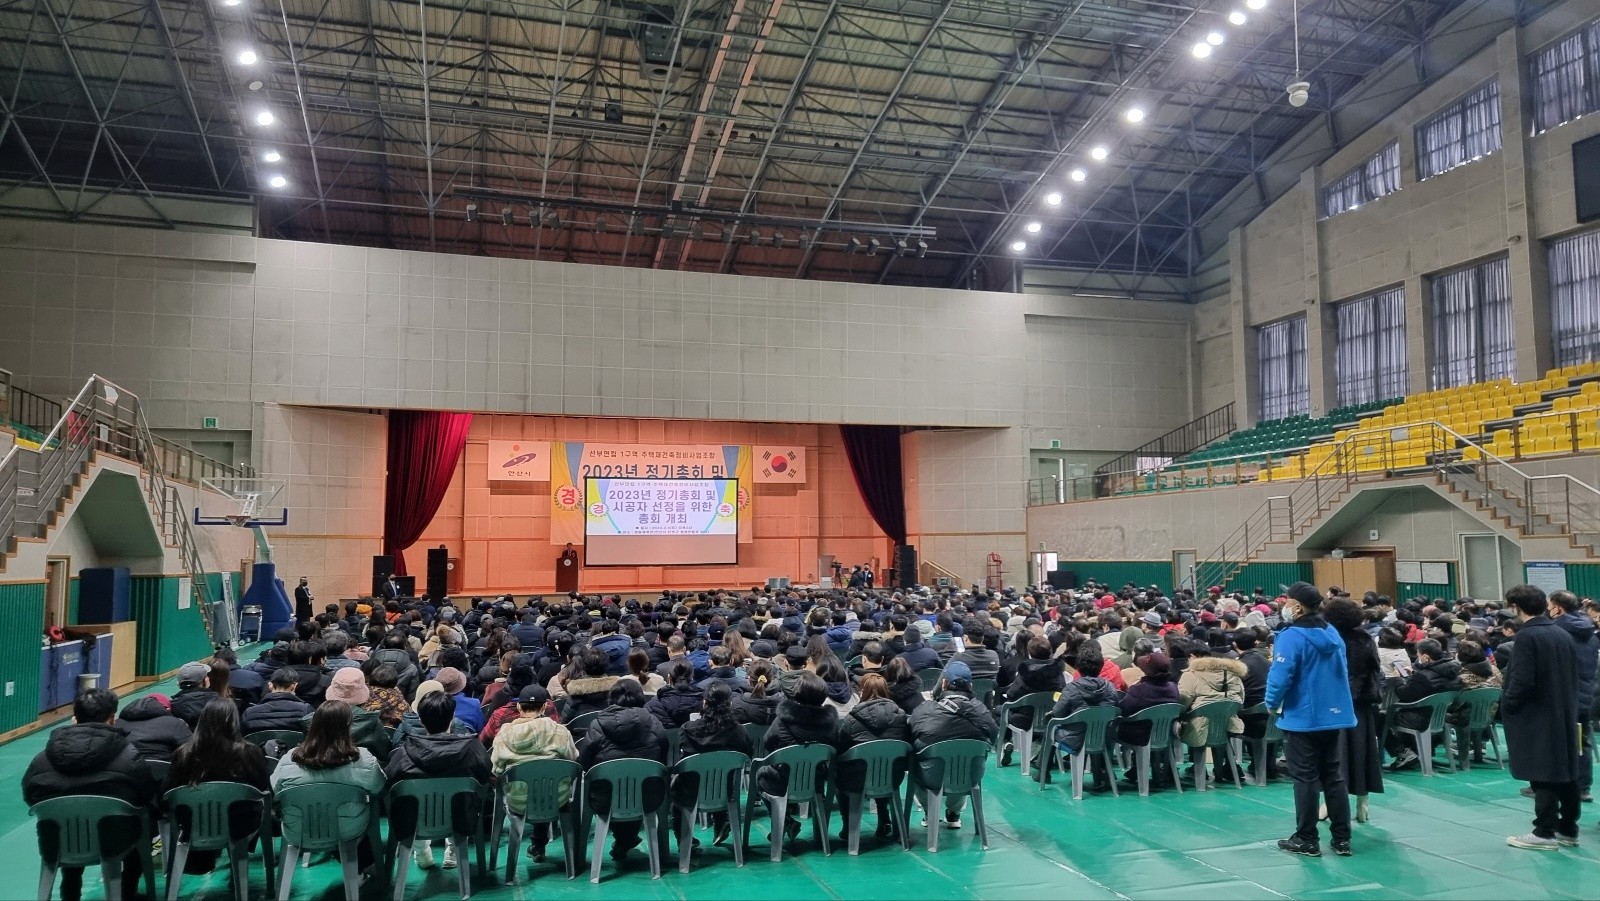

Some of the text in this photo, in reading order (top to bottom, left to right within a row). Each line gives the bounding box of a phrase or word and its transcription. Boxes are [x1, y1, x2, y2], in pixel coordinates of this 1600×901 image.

[589, 450, 617, 458] 선부연립
[582, 464, 638, 478] 2023년
[561, 489, 575, 505] 경
[609, 490, 716, 501] 2023년 정기총회 및
[593, 504, 604, 515] 경
[613, 501, 712, 512] 시공자 선정을 위한
[720, 504, 731, 514] 축
[638, 513, 687, 524] 총회 개최
